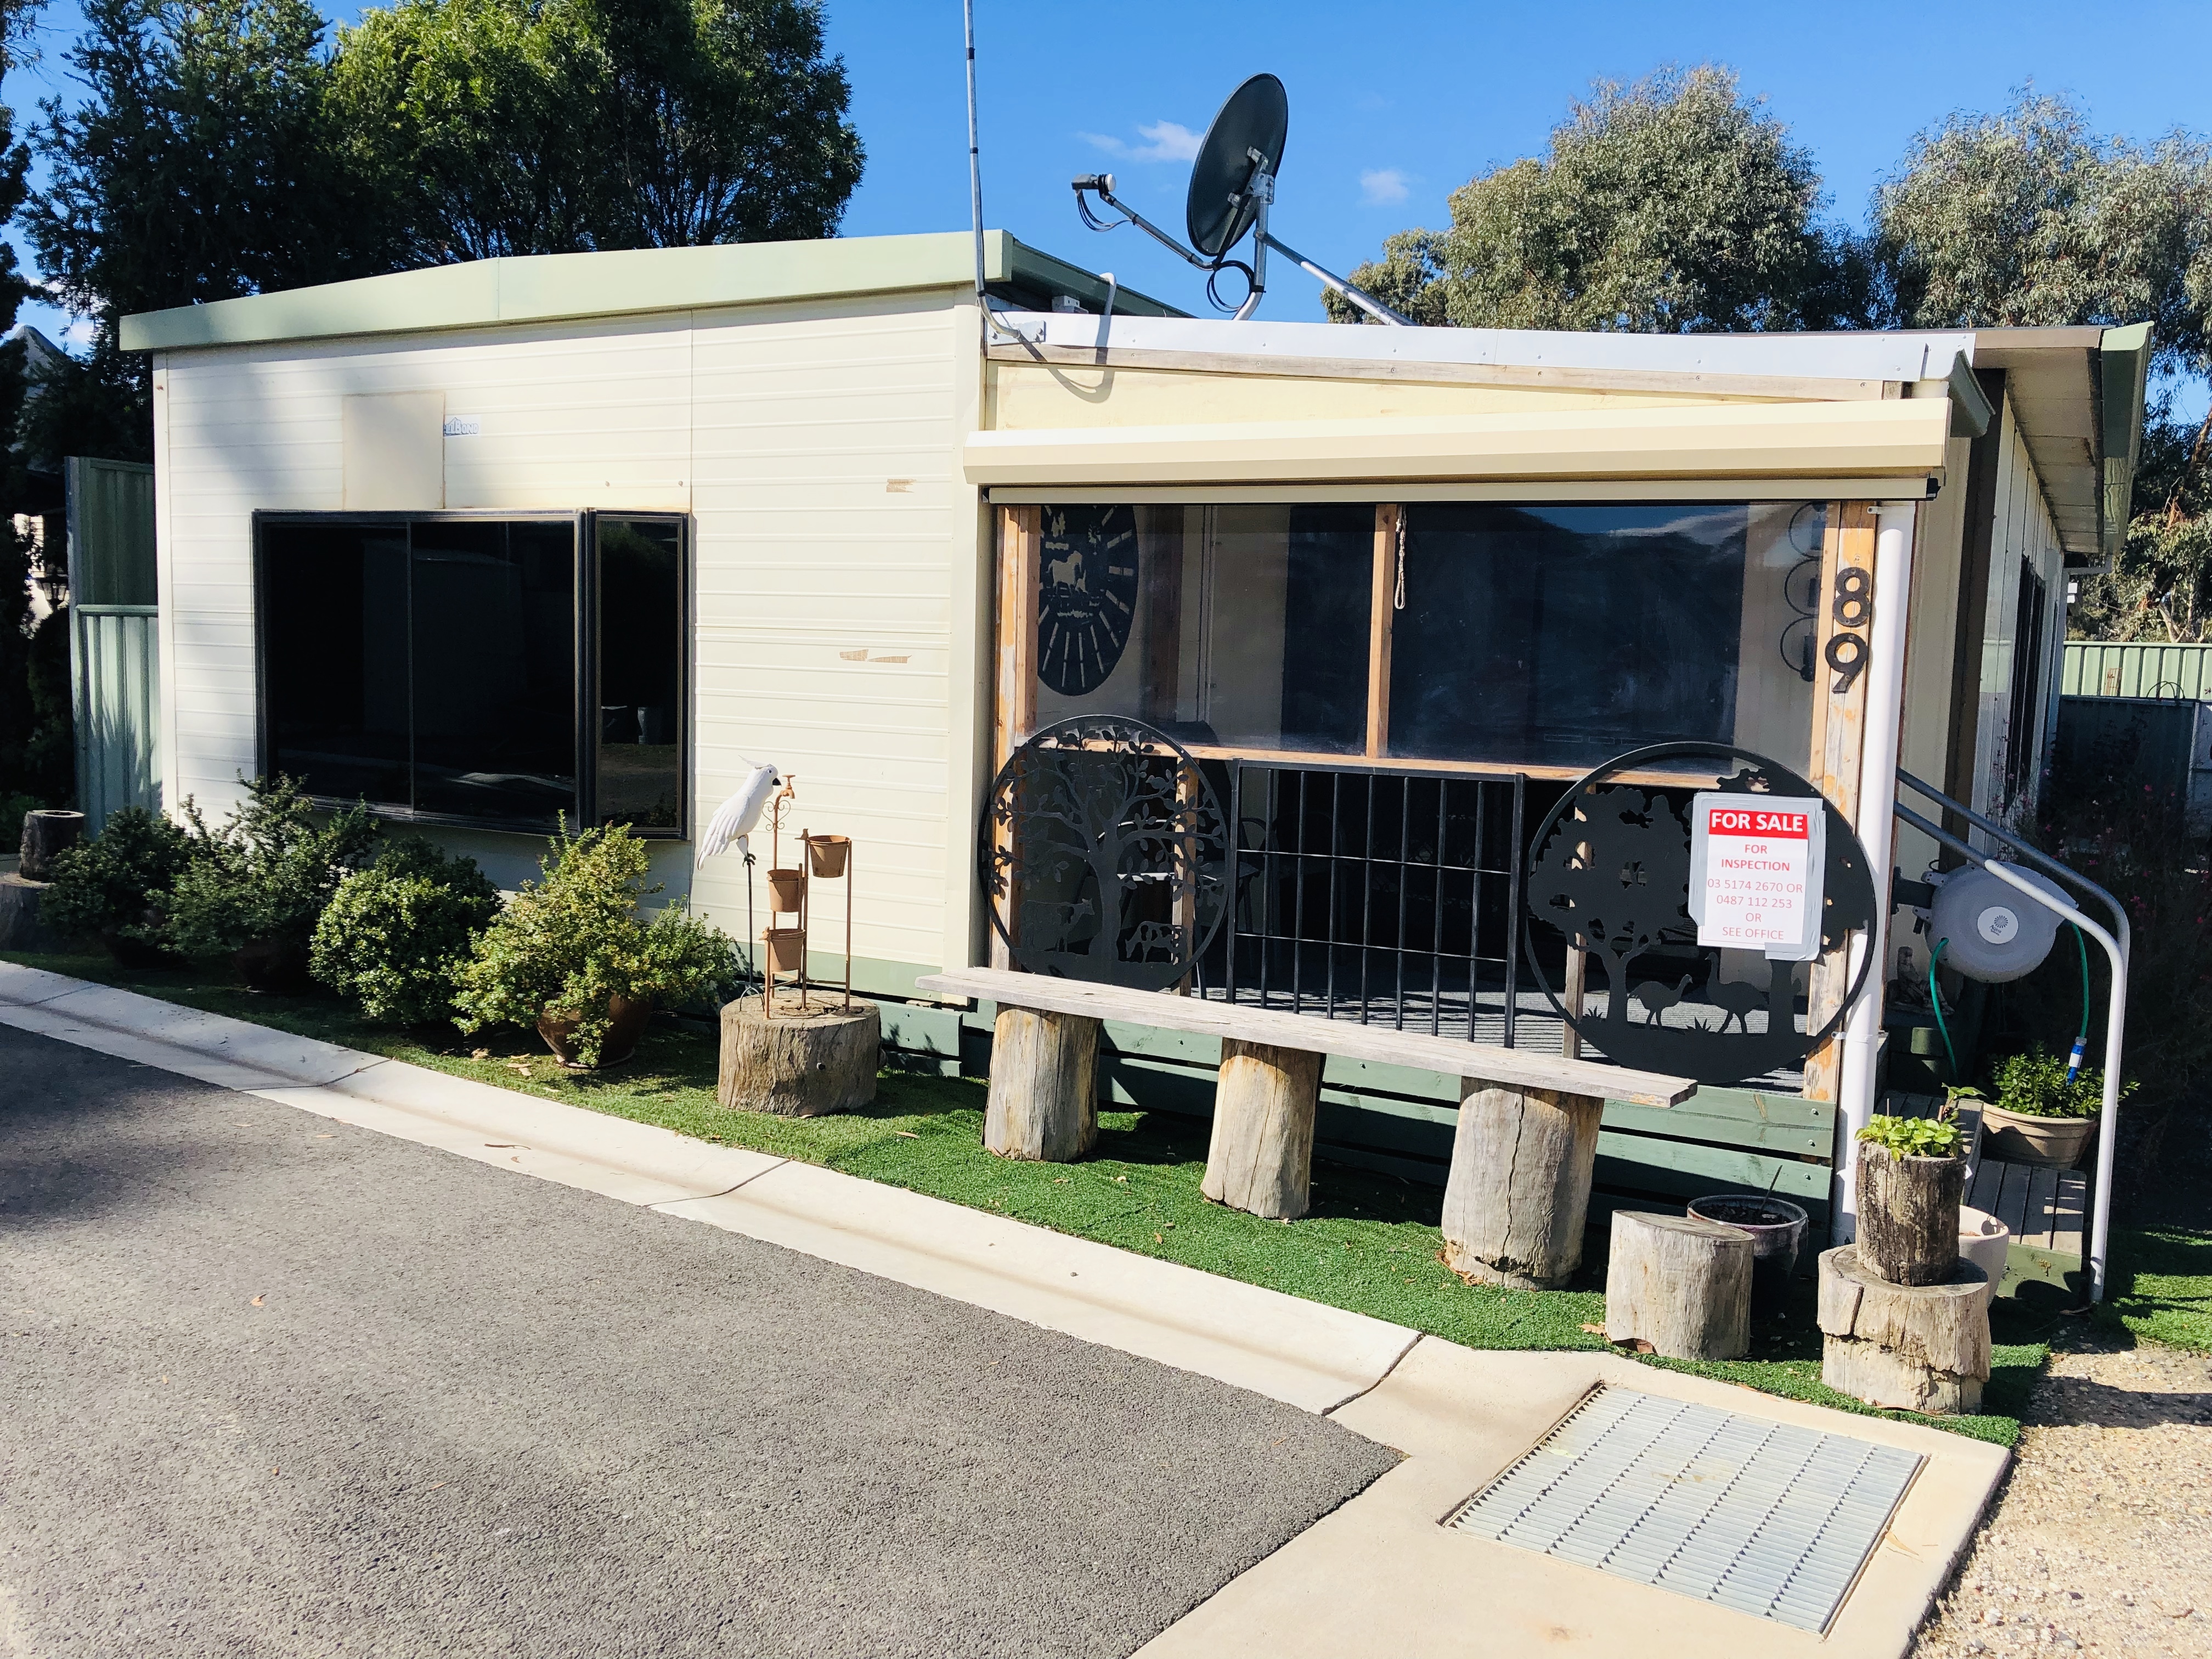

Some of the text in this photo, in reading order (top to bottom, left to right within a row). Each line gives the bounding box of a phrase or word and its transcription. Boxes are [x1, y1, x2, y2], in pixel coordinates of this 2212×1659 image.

[1825, 567, 1872, 694] 89
[1711, 812, 1804, 832] FOR SALE
[1745, 844, 1768, 854] FOR
[1721, 859, 1790, 871] INSPECTION
[1707, 878, 1803, 893] 03 5174 2670 OR
[1717, 895, 1792, 909] 0487 112 253
[1746, 913, 1762, 922] OR
[1722, 927, 1784, 940] SEE OFFICE
